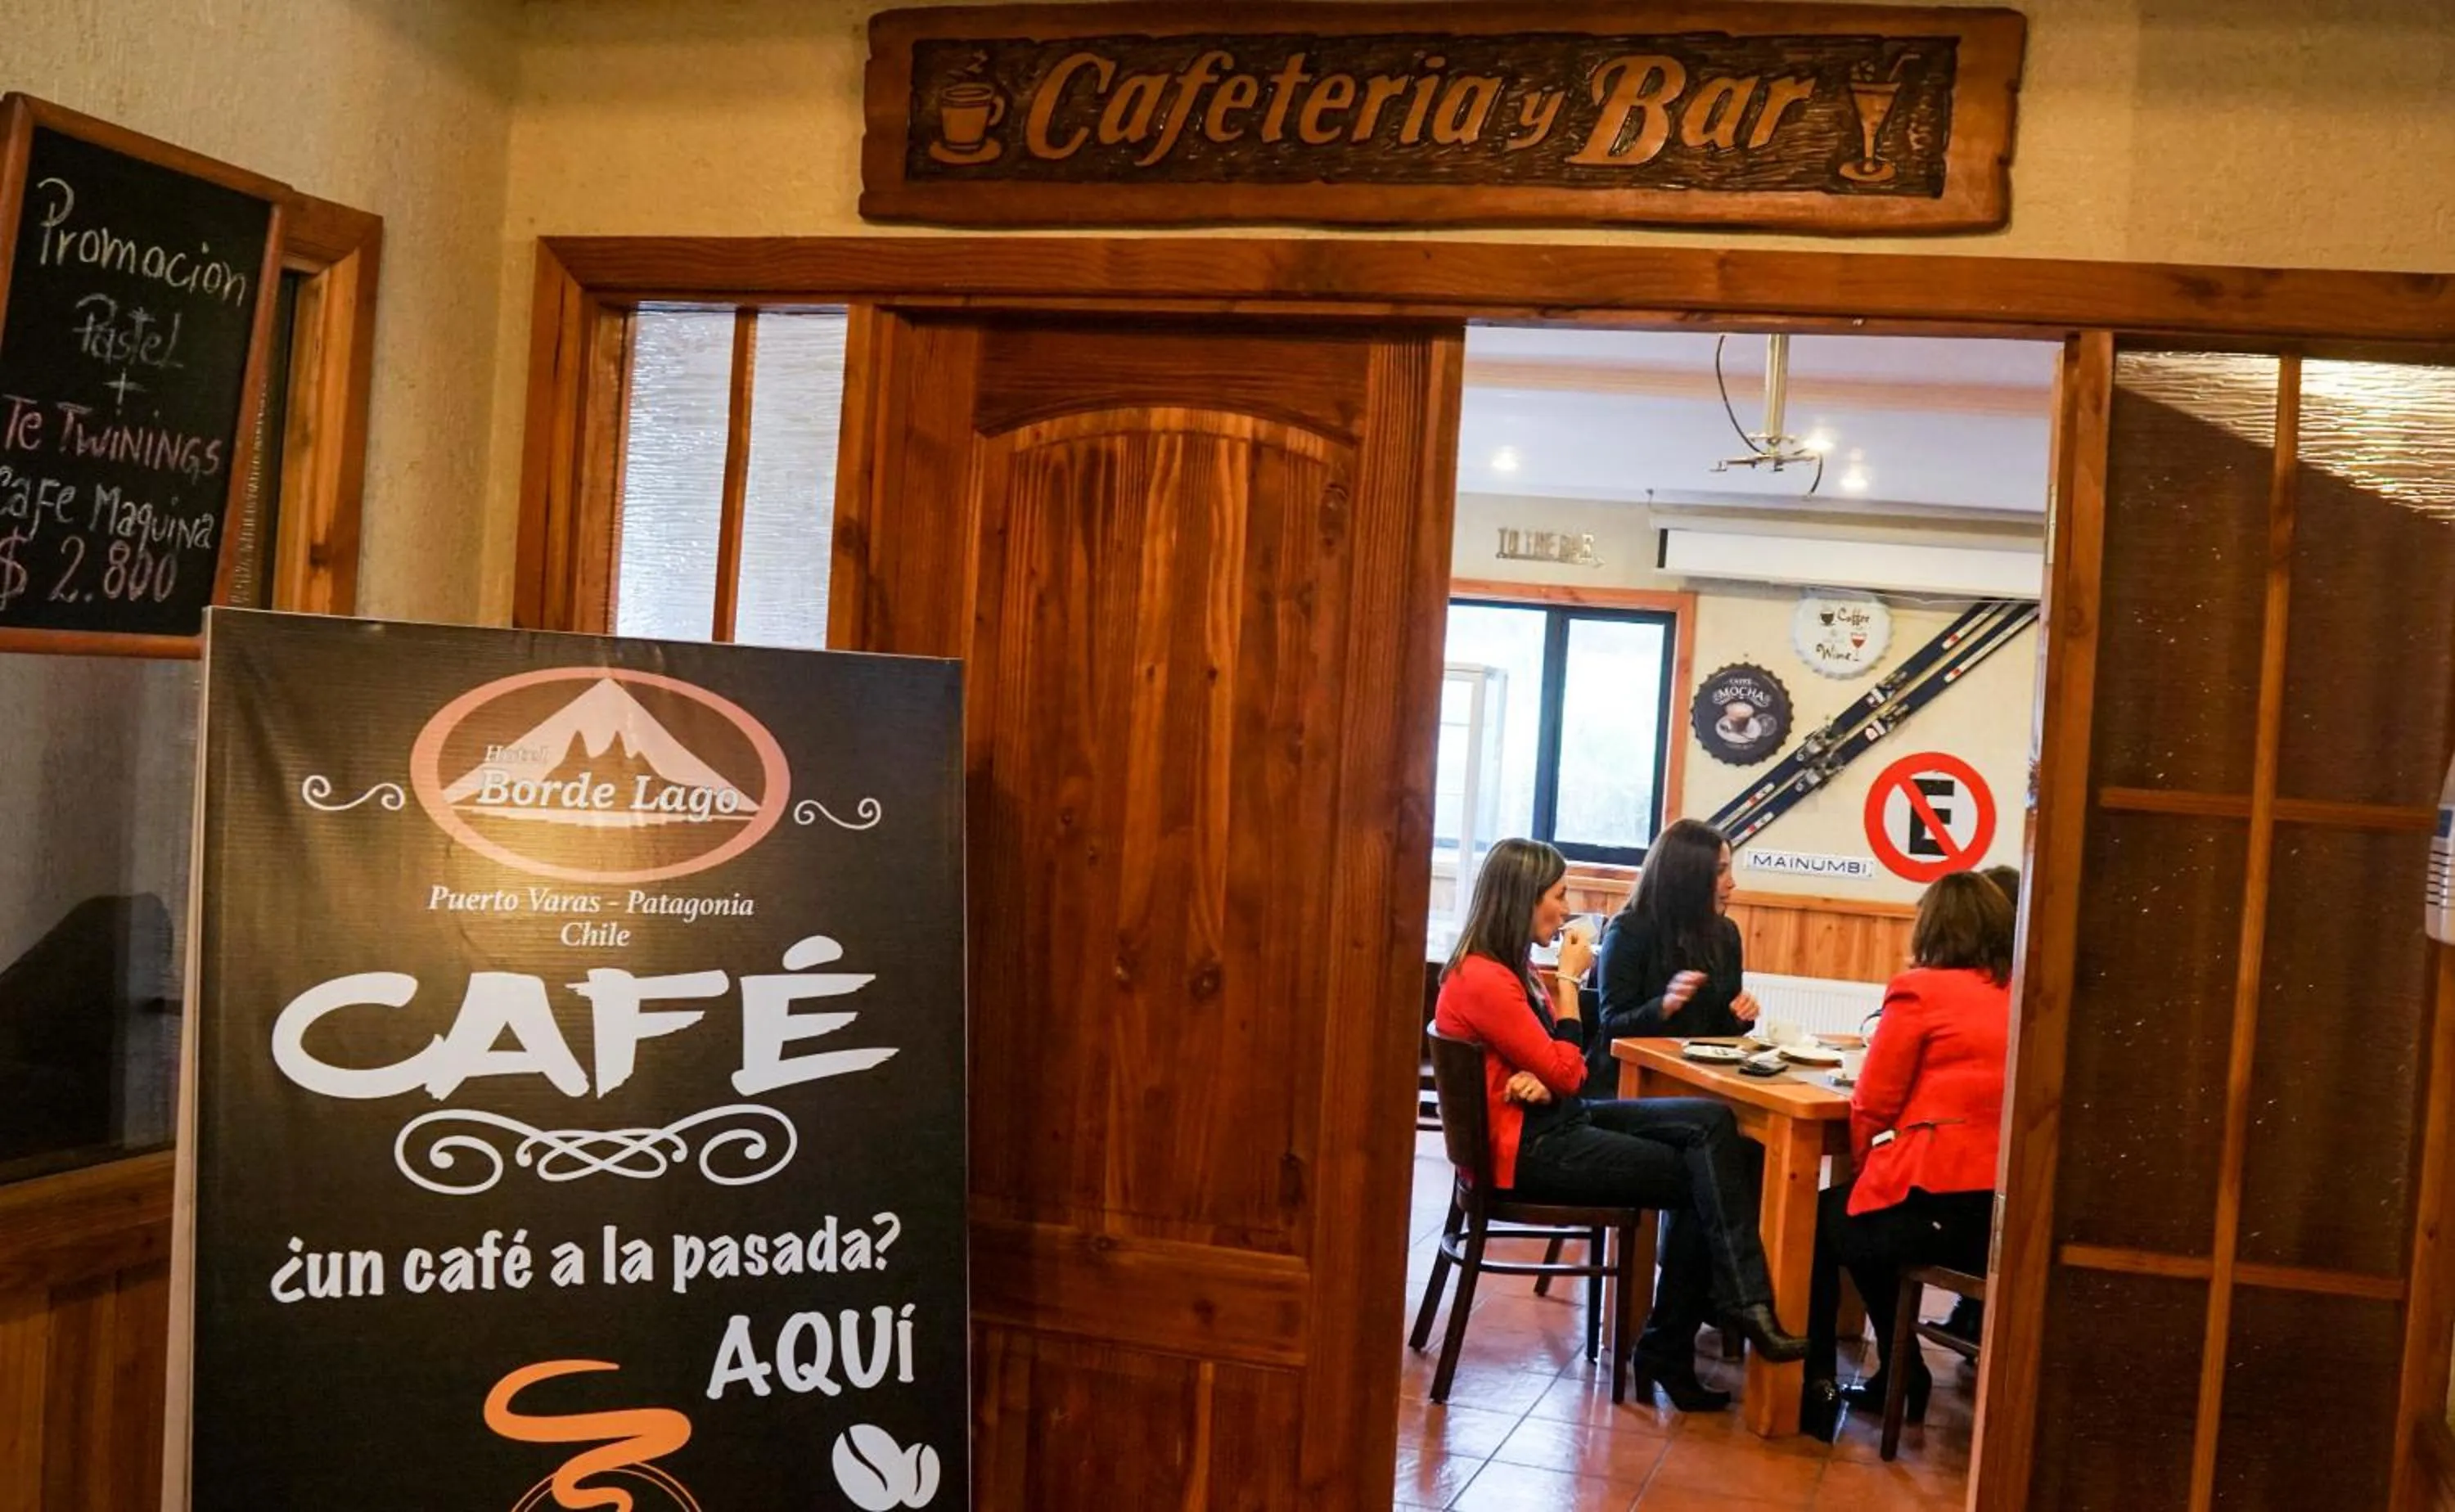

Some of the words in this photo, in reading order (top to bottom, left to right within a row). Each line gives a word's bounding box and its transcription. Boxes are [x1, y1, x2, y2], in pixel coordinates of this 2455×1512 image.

[1025, 51, 1502, 166] Cafeteria
[1506, 90, 1565, 151] y
[1565, 54, 1817, 164] Bar
[2, 394, 42, 450] Te
[0, 527, 29, 610] $
[47, 536, 178, 603] 2.800
[1717, 686, 1765, 701] MOCHA
[476, 768, 615, 810] Borde
[630, 775, 739, 823] Lago
[1753, 854, 1867, 875] MAINUMBI
[427, 885, 520, 914] Puerto
[528, 888, 601, 914] Varas
[625, 889, 755, 924] Patagonia
[560, 922, 632, 947] Chile
[271, 935, 899, 1100] CAFÉ
[270, 1236, 384, 1303] ¿un
[403, 1230, 534, 1292] café
[550, 1240, 585, 1288] a
[603, 1225, 655, 1285] la
[673, 1212, 902, 1294] pasada?
